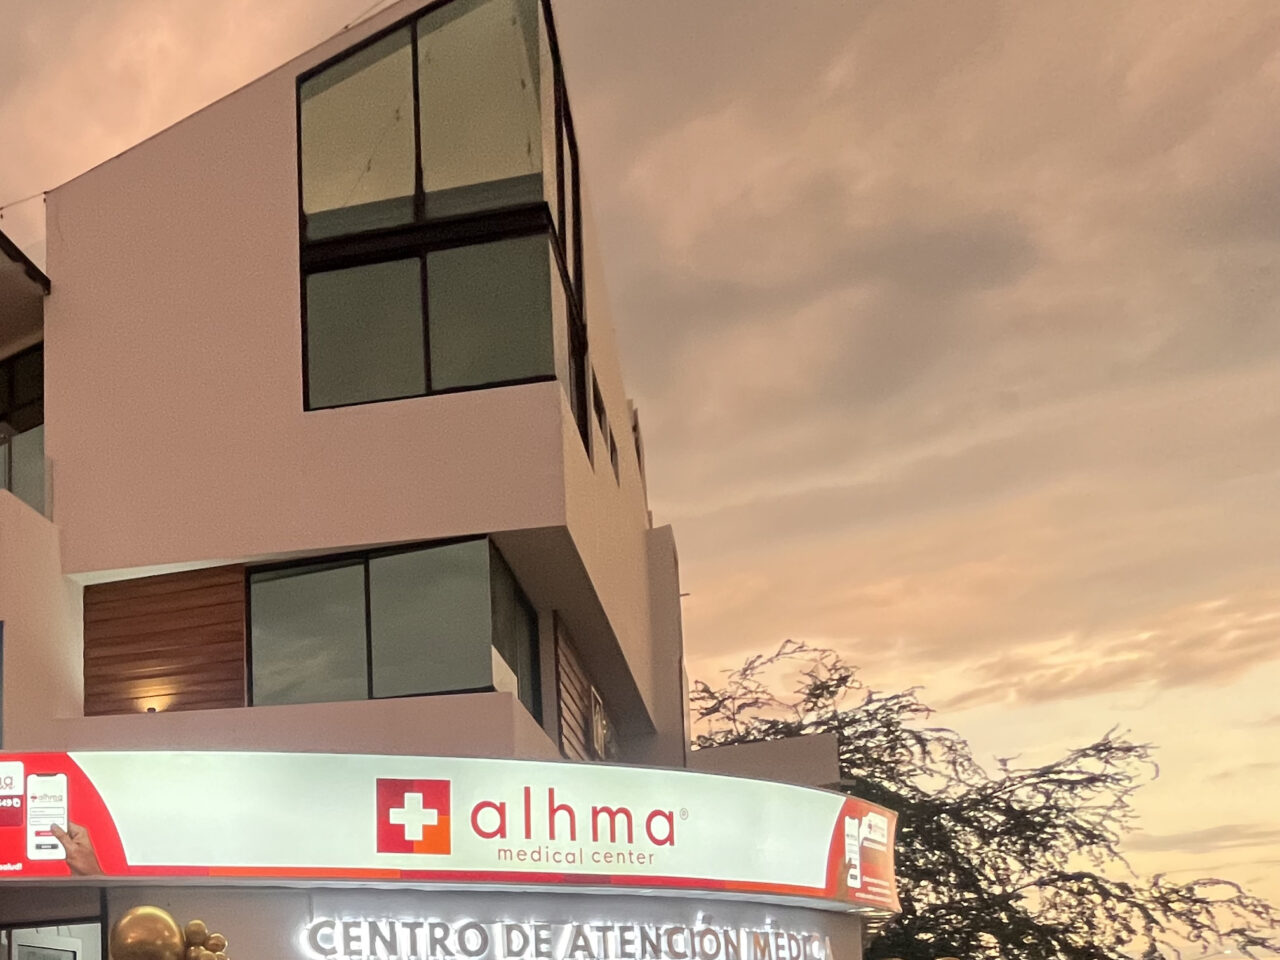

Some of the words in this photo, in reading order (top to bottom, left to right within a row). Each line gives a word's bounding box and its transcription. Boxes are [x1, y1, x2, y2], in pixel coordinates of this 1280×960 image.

[470, 786, 675, 846] alhma
[497, 846, 583, 864] medical
[591, 848, 655, 865] center
[308, 920, 489, 958] CENTRO
[505, 923, 553, 959] DE
